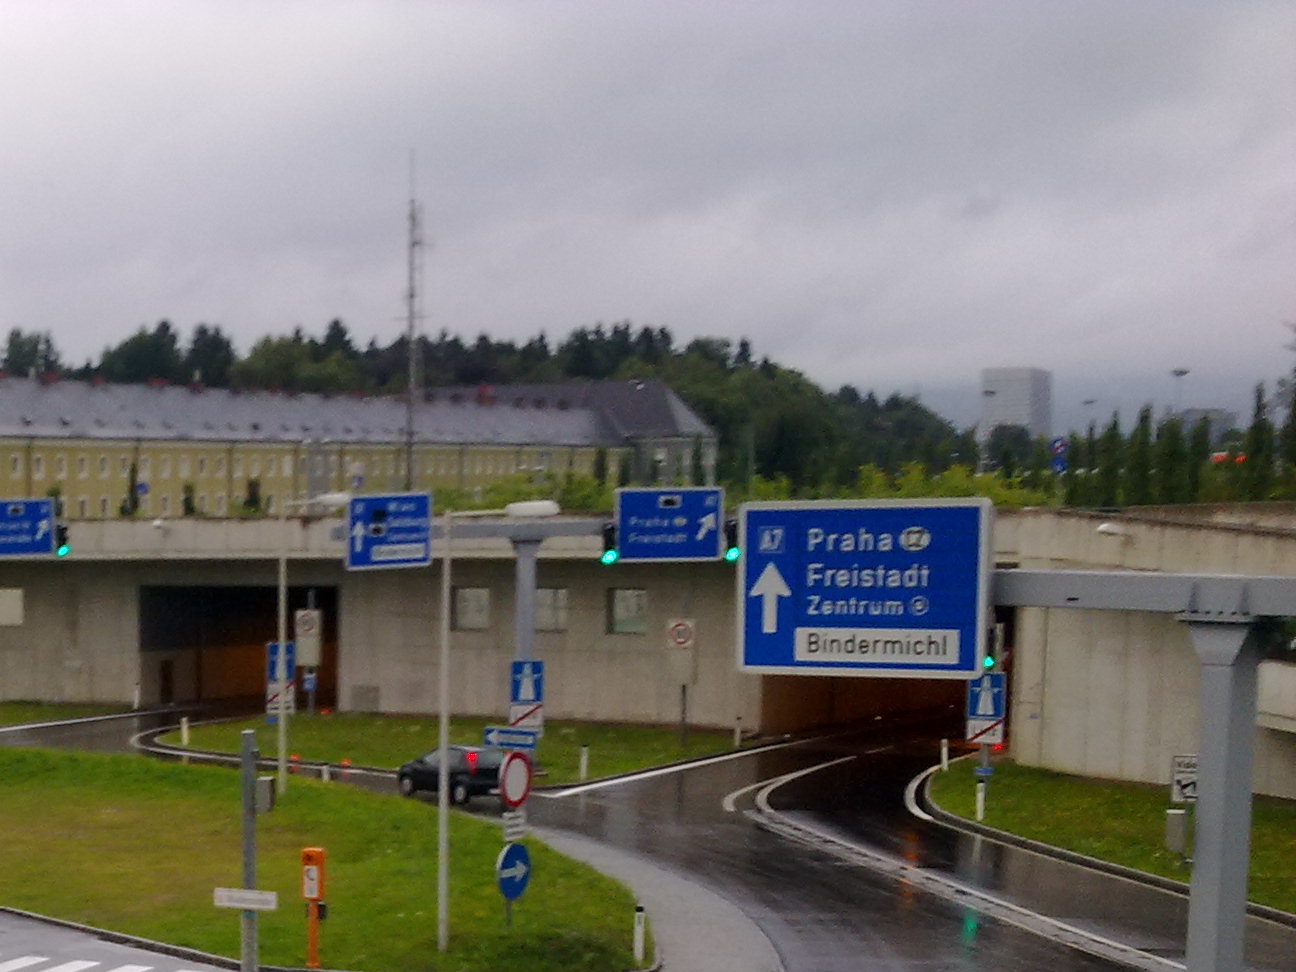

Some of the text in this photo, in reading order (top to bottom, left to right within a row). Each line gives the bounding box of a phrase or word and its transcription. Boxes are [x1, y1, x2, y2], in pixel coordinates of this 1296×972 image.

[807, 528, 894, 551] Praha
[807, 563, 929, 587] Freistadt
[807, 596, 903, 615] Zentrum
[807, 633, 948, 656] Bindermichl
